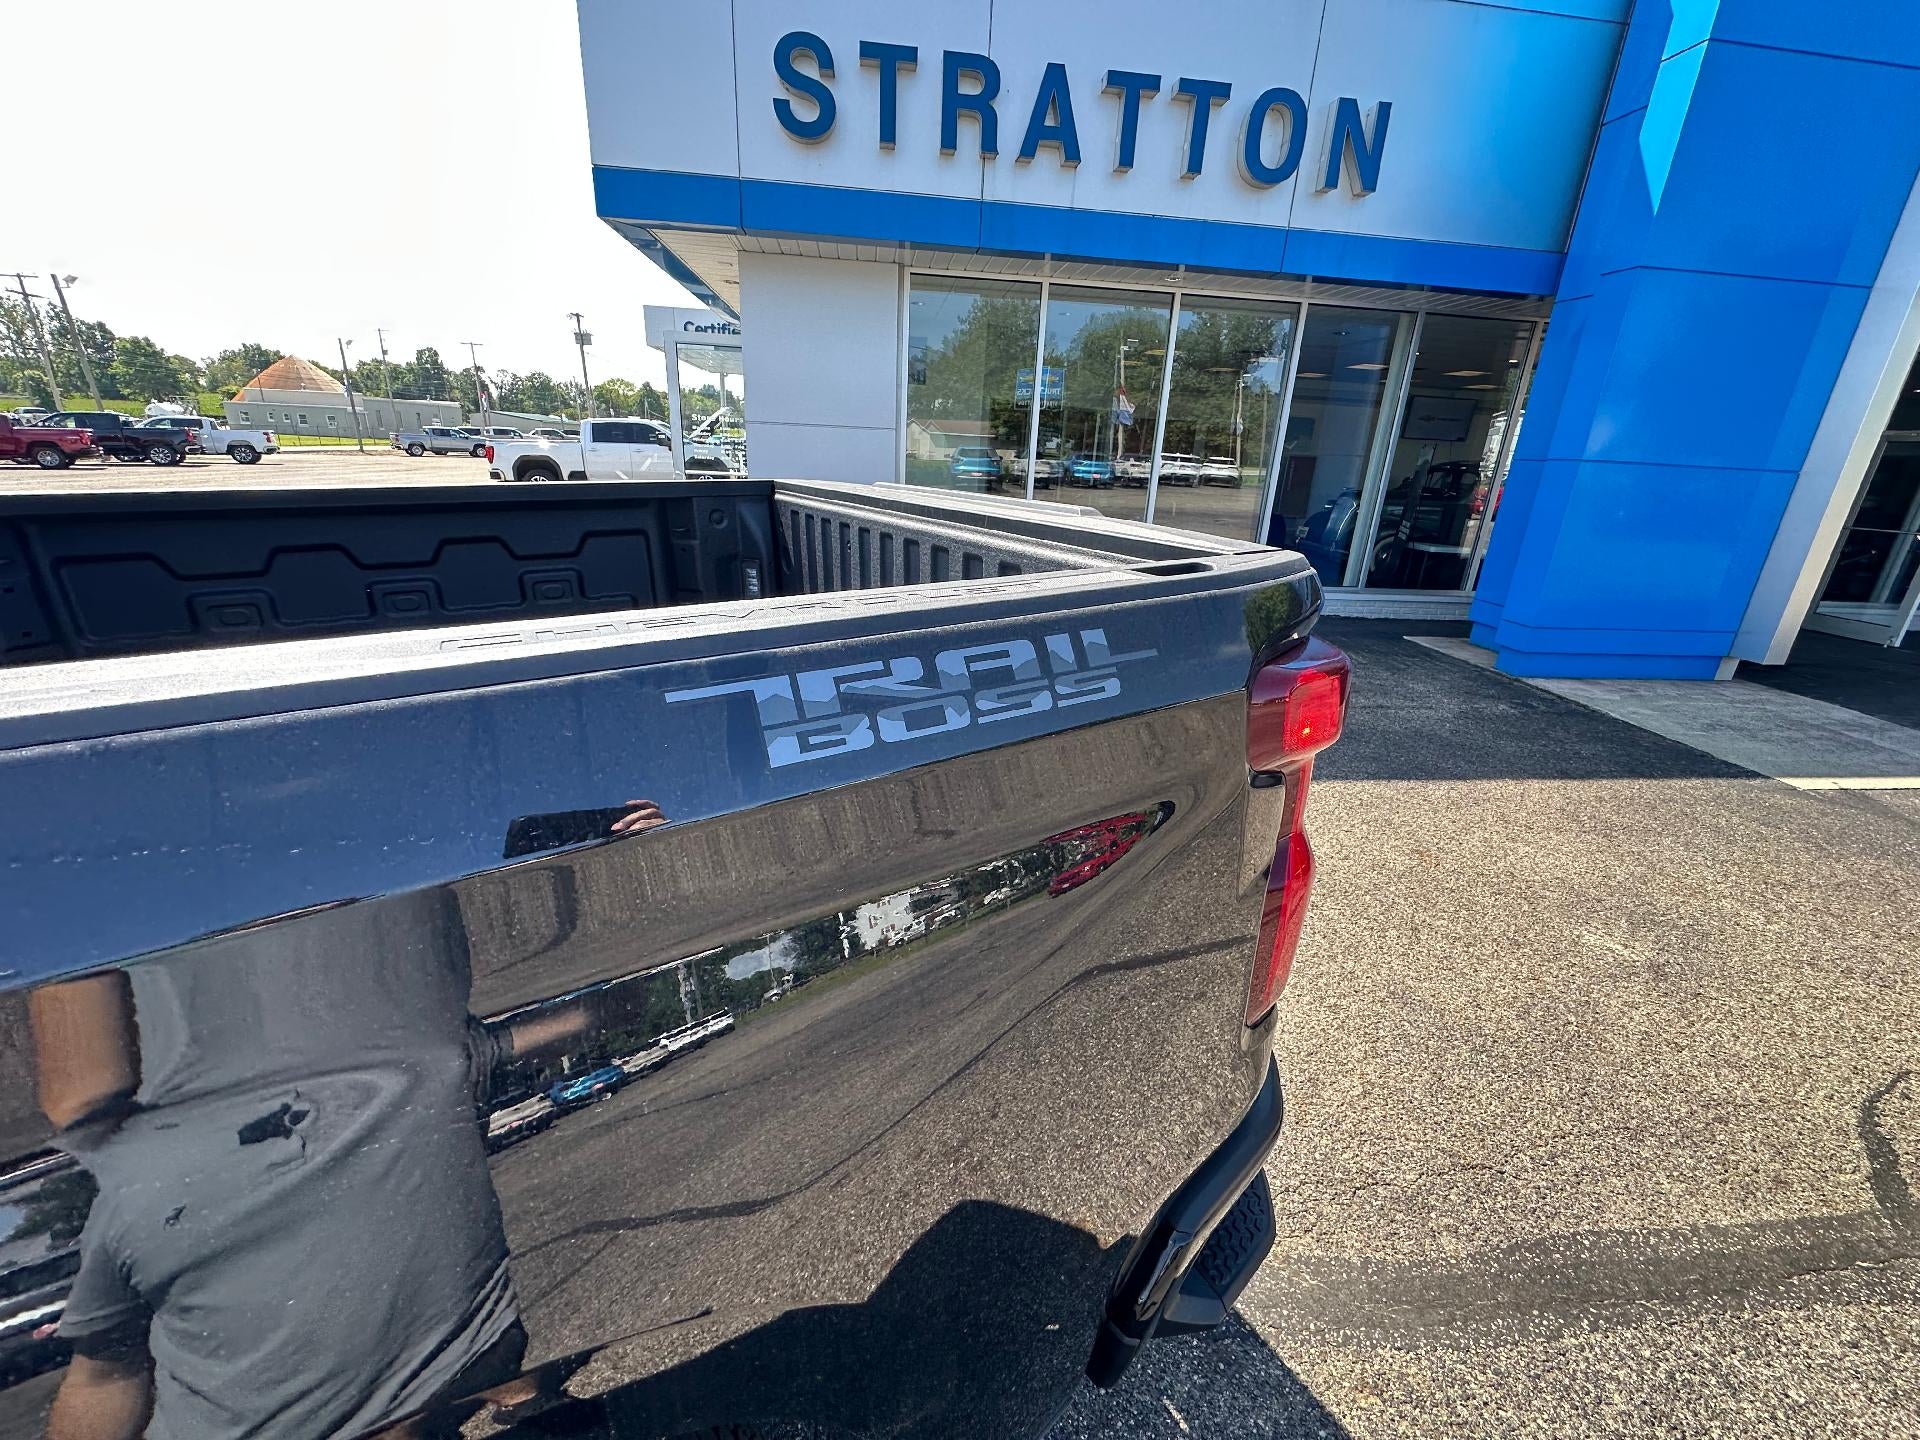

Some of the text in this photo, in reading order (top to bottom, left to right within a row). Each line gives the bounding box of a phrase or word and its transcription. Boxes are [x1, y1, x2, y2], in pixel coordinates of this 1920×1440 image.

[773, 31, 1392, 198] STRATTON
[718, 415, 744, 423] Hours
[439, 580, 1042, 652] CHEVROLET
[664, 628, 1159, 727] TRAIL
[763, 666, 1121, 769] BOSS
